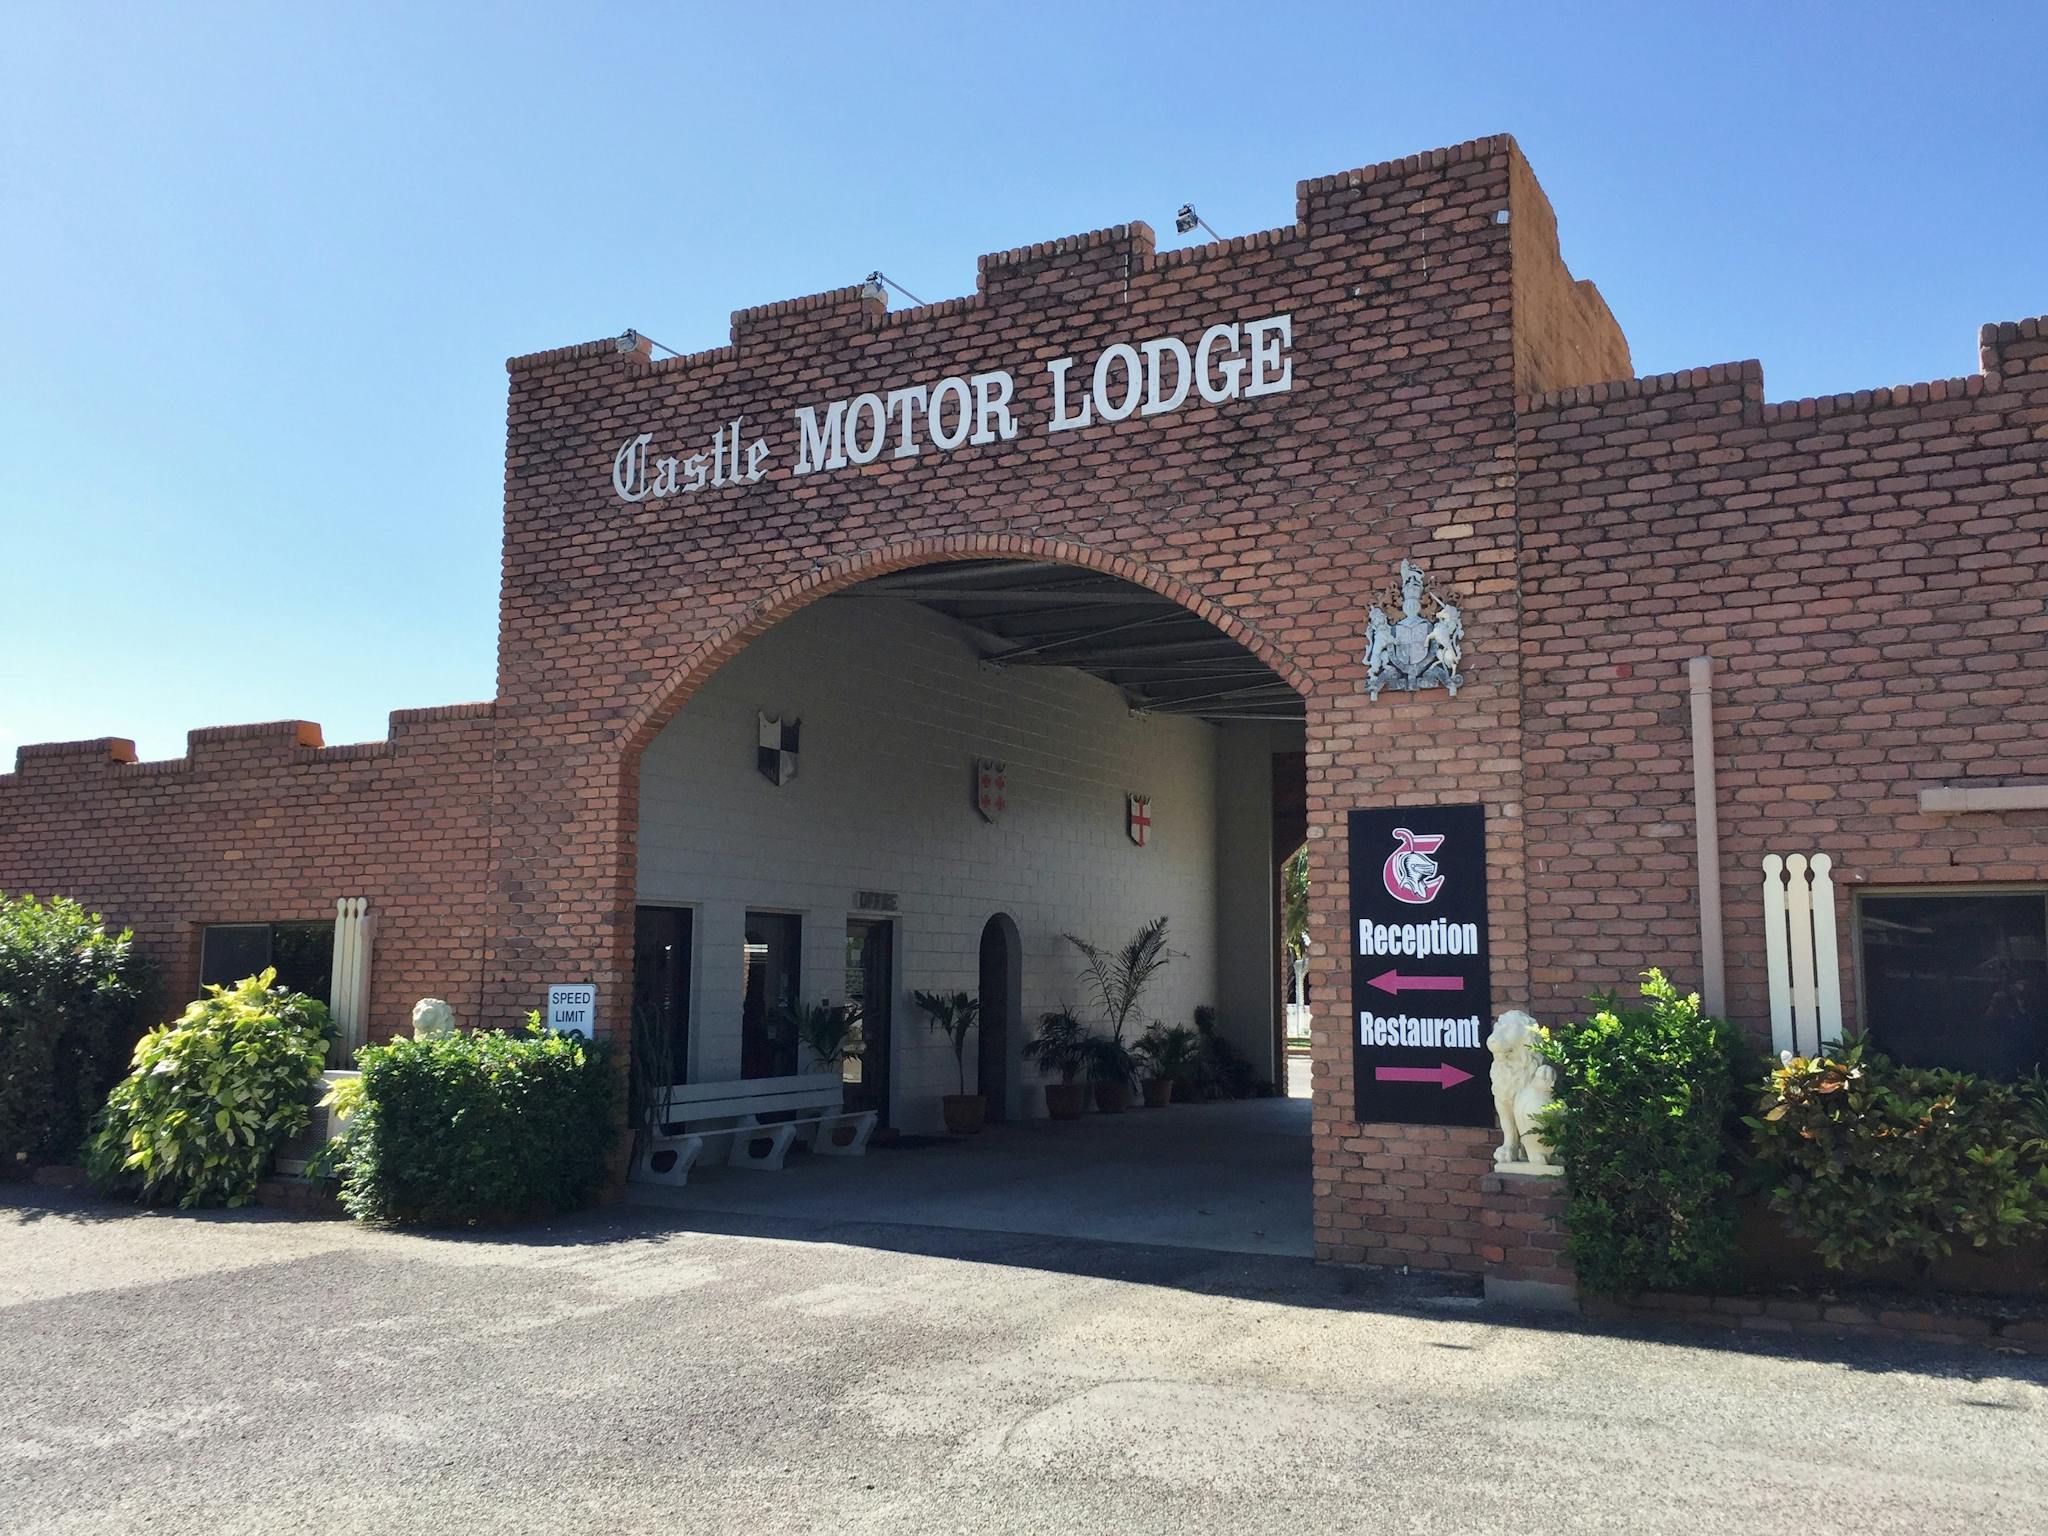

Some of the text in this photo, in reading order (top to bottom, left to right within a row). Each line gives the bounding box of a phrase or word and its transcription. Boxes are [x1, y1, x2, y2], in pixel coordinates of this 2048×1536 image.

[613, 313, 1293, 501] Castle MOTOR LODGE
[1358, 917, 1478, 959] Reception
[552, 992, 591, 1005] SPEED
[555, 1010, 586, 1022] LIMIT
[1360, 1011, 1481, 1049] Restaurant
